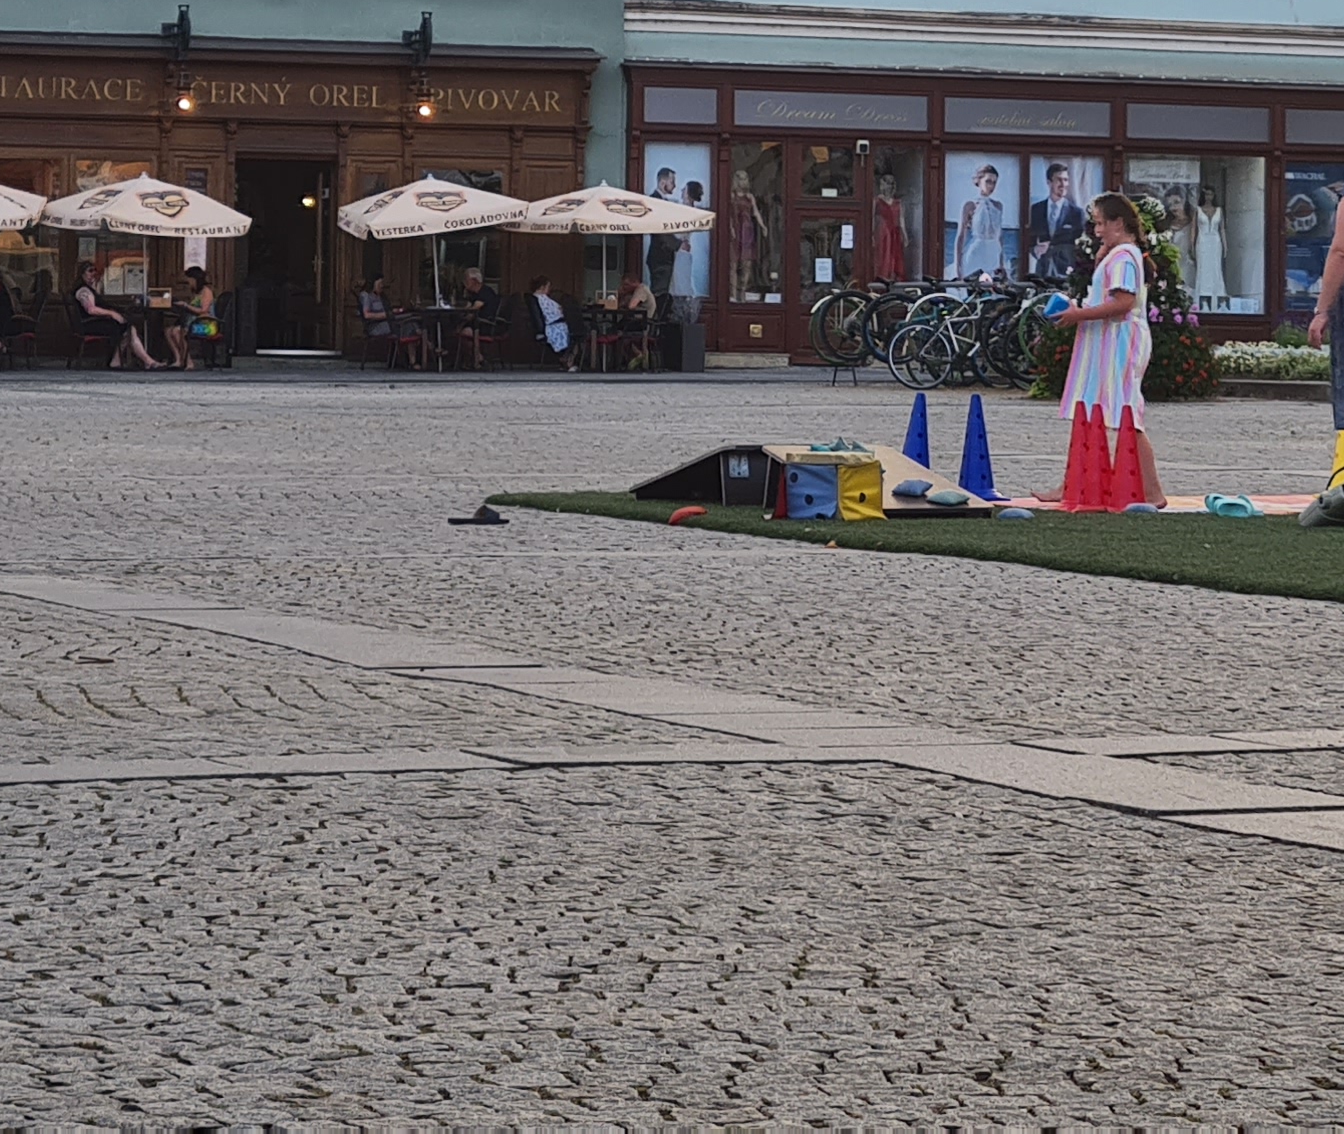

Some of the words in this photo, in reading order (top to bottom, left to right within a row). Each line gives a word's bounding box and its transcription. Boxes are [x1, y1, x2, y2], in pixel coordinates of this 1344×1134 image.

[190, 75, 292, 106] ČERNÝ
[309, 83, 386, 109] OREL
[433, 86, 562, 113] PIVOVAR
[756, 98, 836, 120] Dream
[174, 224, 248, 235] RESTAURANT
